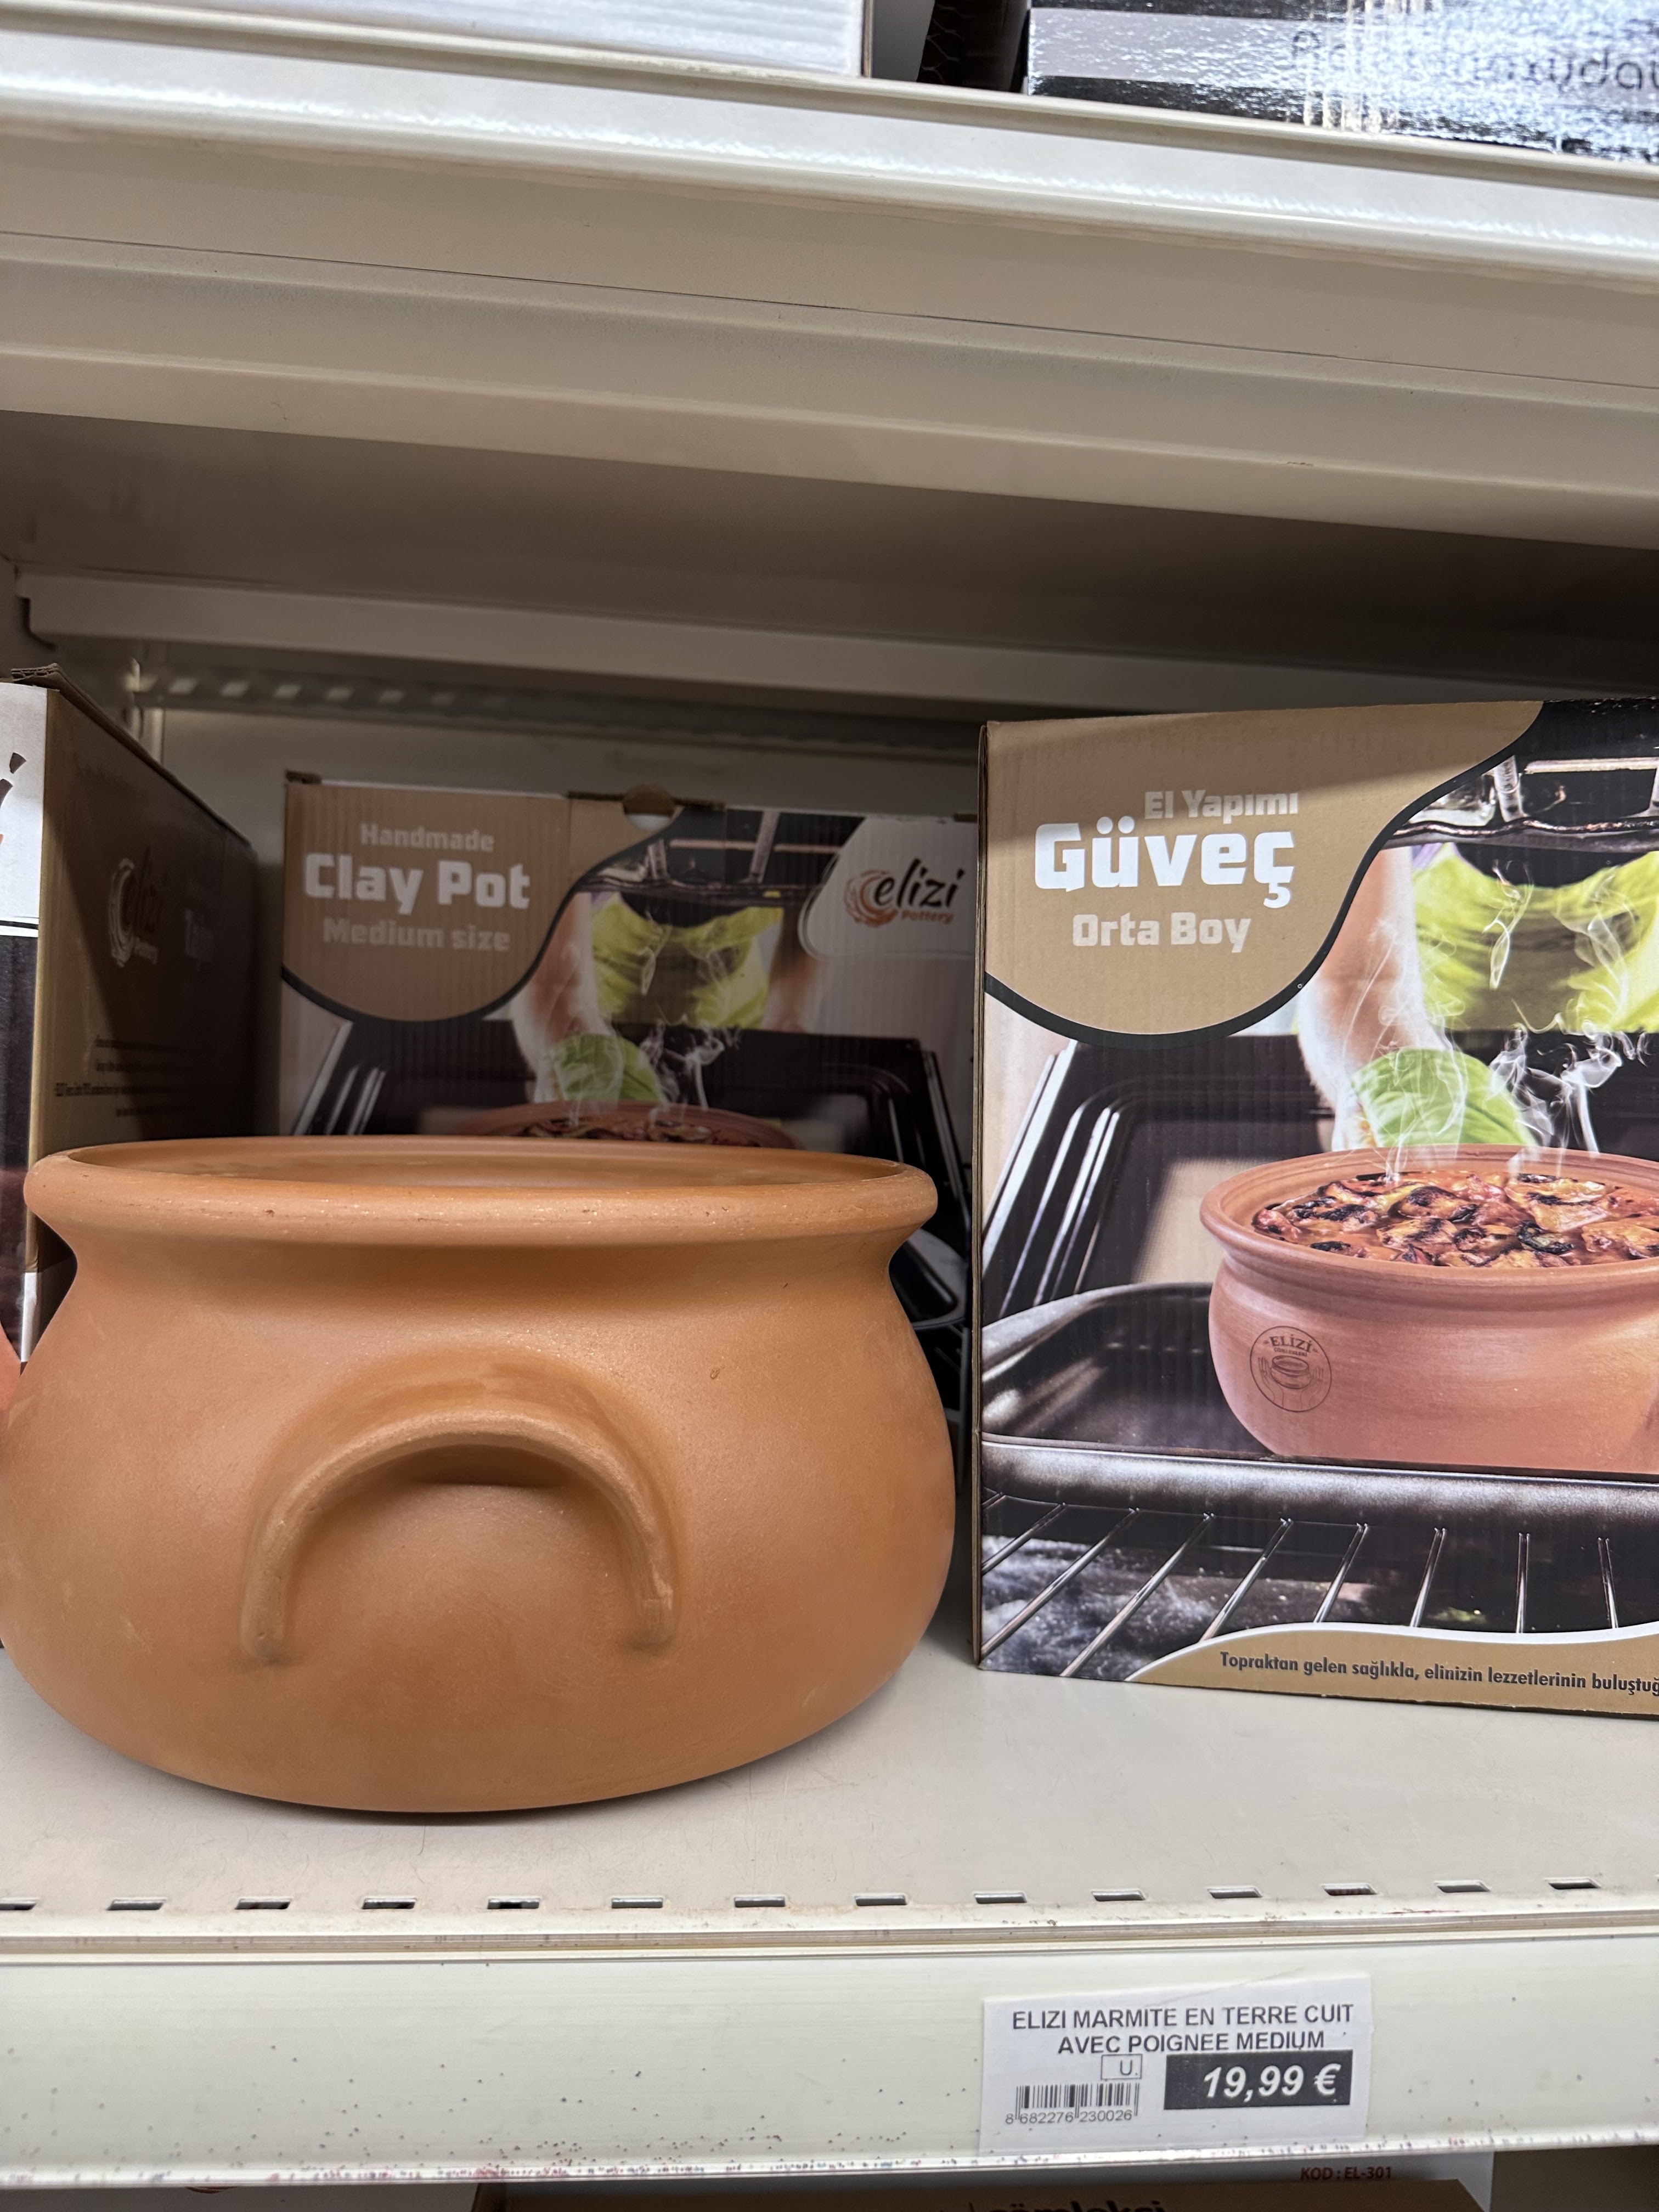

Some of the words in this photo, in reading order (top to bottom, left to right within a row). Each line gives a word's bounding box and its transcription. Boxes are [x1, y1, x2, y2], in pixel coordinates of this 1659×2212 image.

[1144, 790, 1174, 820] El
[1181, 789, 1299, 825] Yapımı
[360, 822, 494, 852] Handmade
[1035, 816, 1295, 909] Güveç
[304, 853, 424, 915] Clay
[437, 860, 531, 910] Pot
[874, 858, 964, 908] elizi
[323, 917, 445, 949] Medium
[452, 924, 511, 951] size
[1073, 912, 1160, 946] Orta
[1170, 911, 1251, 953] Boy
[1220, 1651, 1299, 1671] Topraktan
[1304, 1656, 1347, 1675] gelen
[1352, 1660, 1420, 1680] sağlıkla,
[1424, 1663, 1482, 1682] elinizin
[1488, 1666, 1587, 1689] lezzetlerinin
[1013, 2010, 1066, 2030] ELIZI
[1073, 2007, 1178, 2029] MARMITE
[1185, 2006, 1215, 2025] EN
[1222, 2005, 1297, 2024] TERRE
[1304, 2004, 1354, 2023] CUIT
[1058, 2035, 1121, 2054] AVEC
[1128, 2033, 1229, 2053] POIGNEE
[1237, 2031, 1324, 2051] MEDIUM
[1203, 2064, 1304, 2102] 19,99
[1313, 2063, 1342, 2095] €
[1300, 2167, 1334, 2180] KOD
[1344, 2166, 1392, 2179] EL-301
